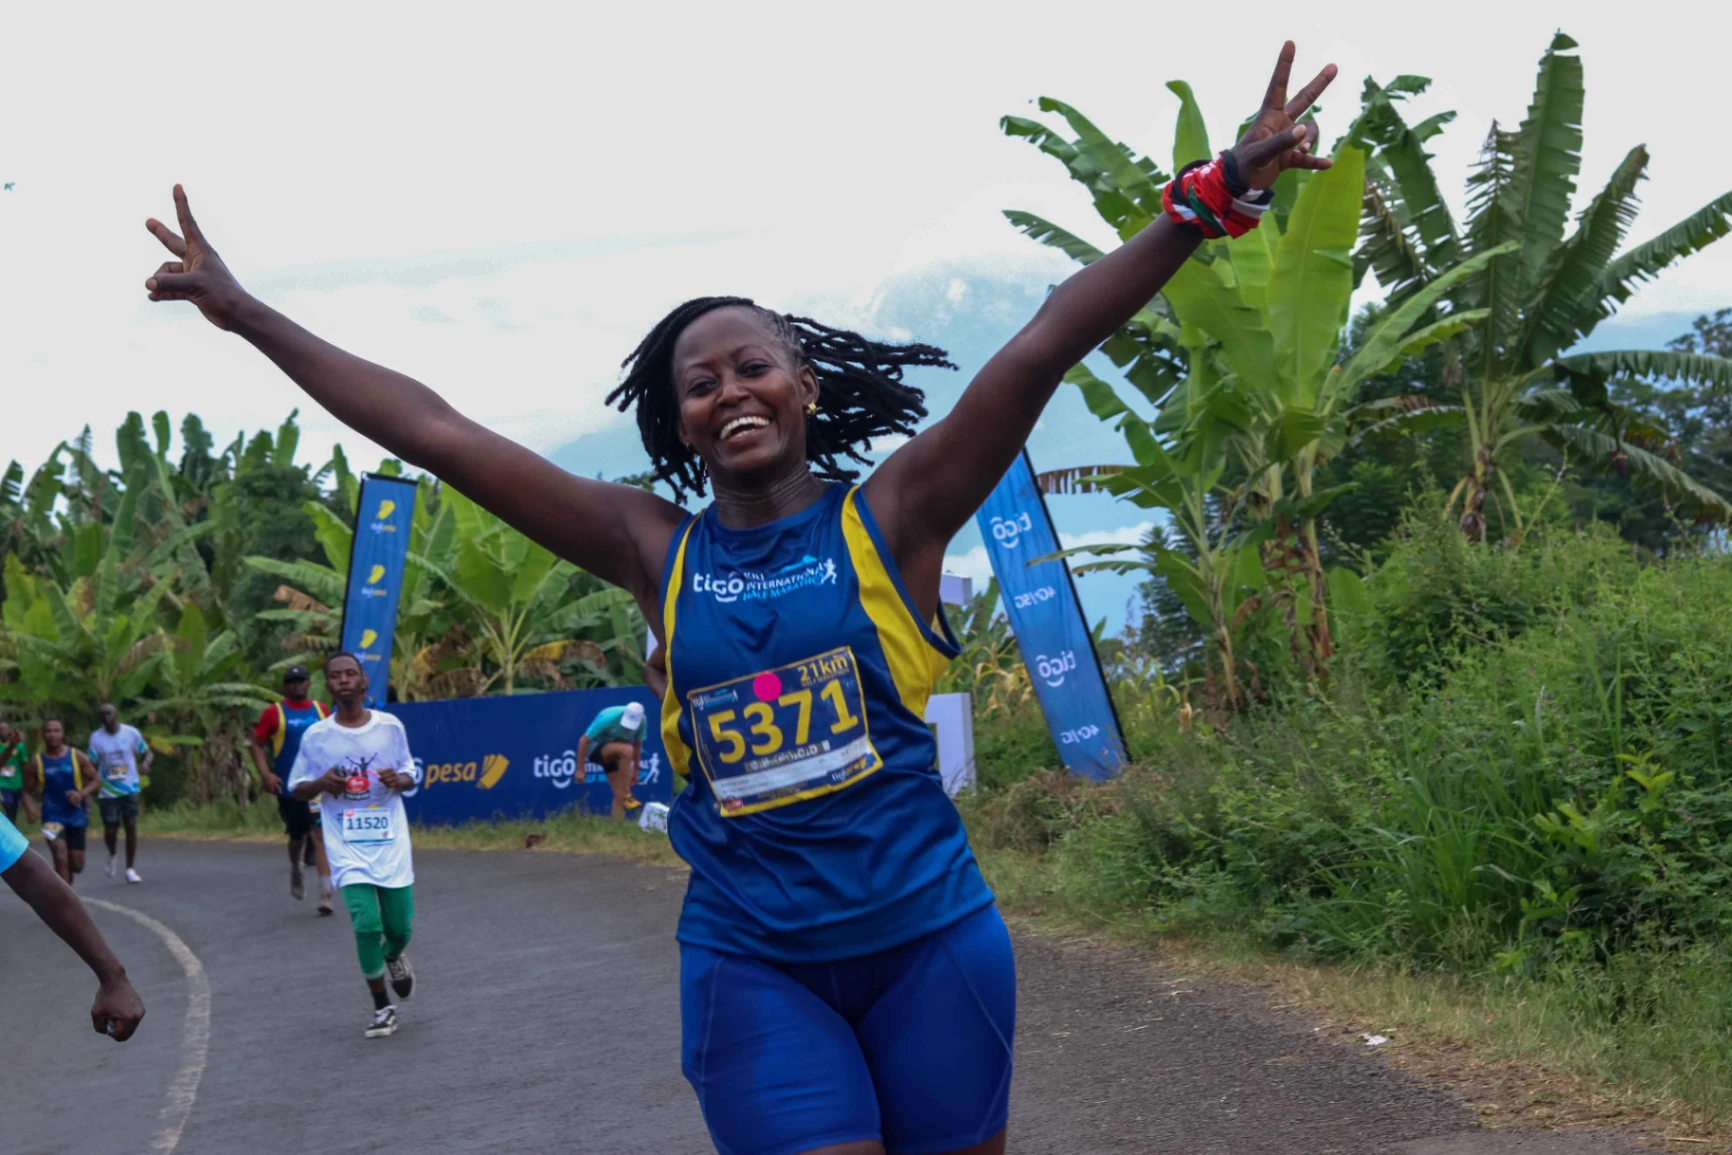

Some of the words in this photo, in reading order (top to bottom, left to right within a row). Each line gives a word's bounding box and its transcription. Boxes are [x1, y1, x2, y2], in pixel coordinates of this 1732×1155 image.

[746, 562, 824, 592] INTERNATIONAL
[797, 655, 848, 682] 21km
[707, 679, 858, 764] 5371
[424, 761, 477, 790] pesa
[346, 816, 389, 830] 11520
